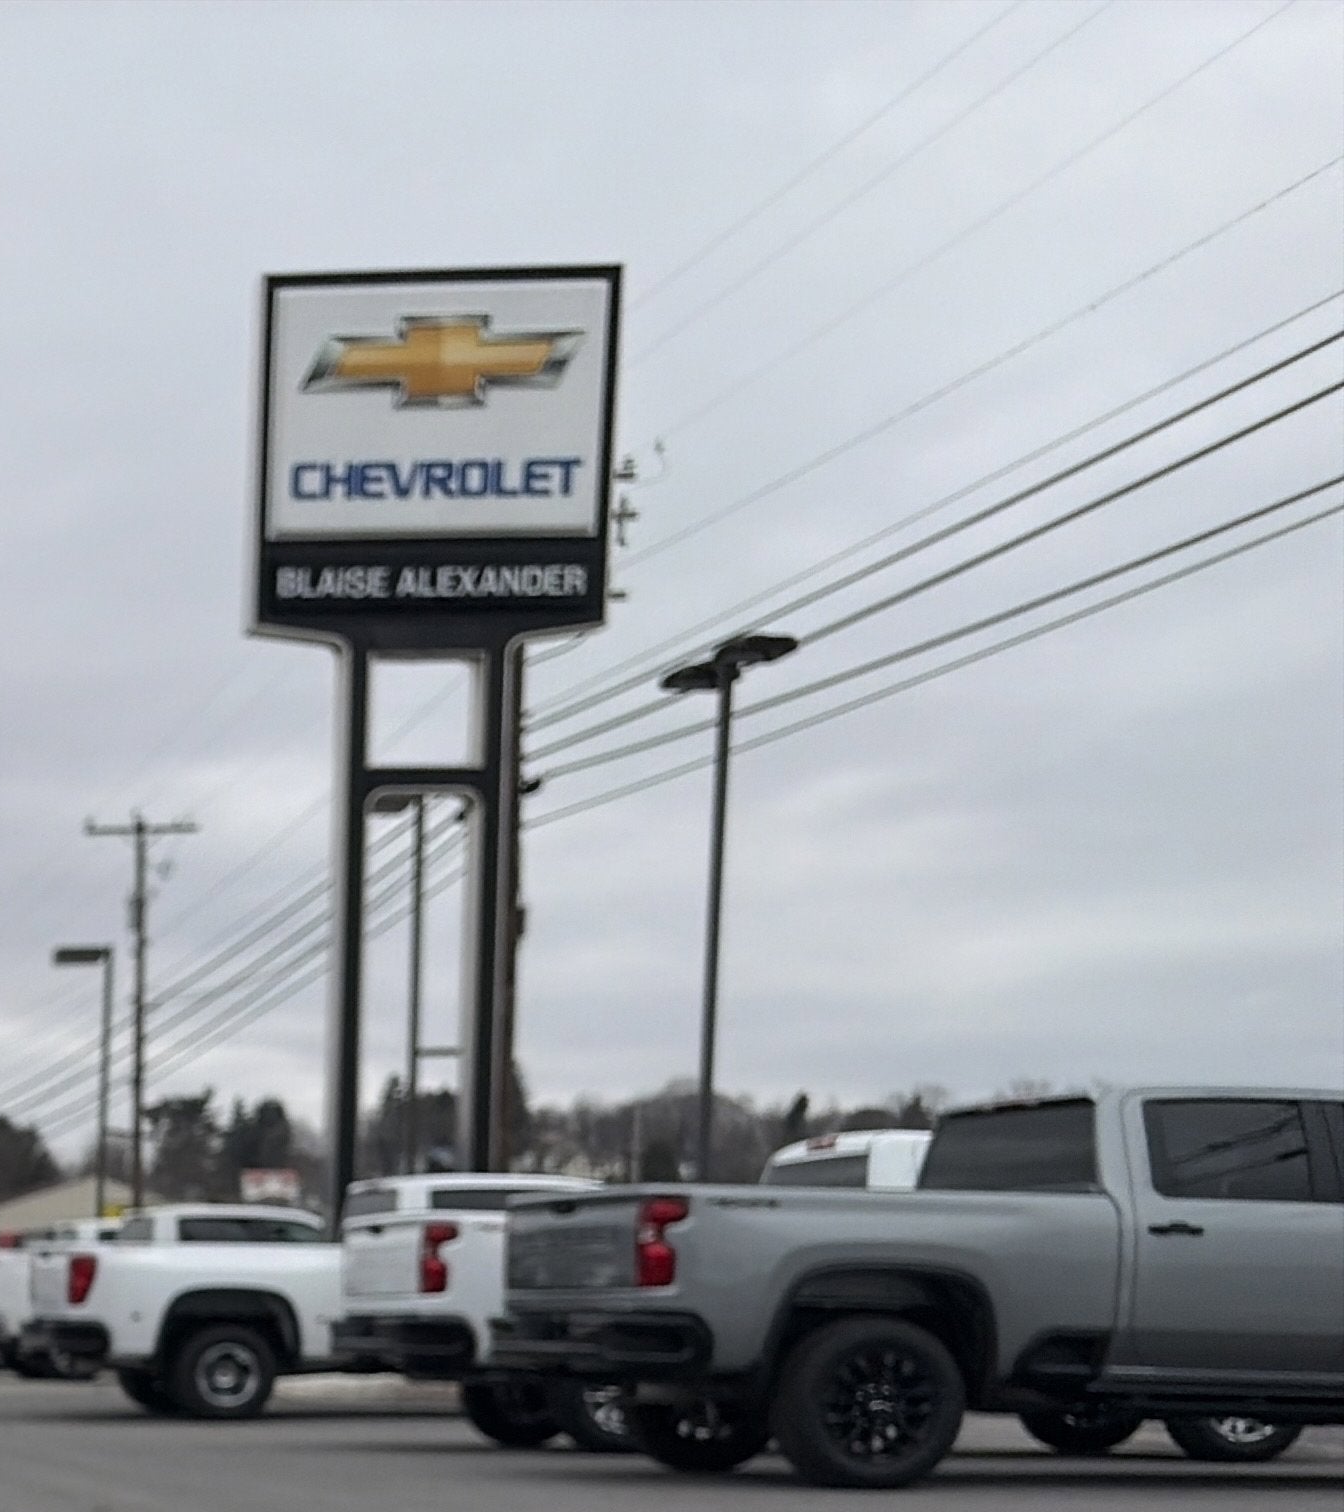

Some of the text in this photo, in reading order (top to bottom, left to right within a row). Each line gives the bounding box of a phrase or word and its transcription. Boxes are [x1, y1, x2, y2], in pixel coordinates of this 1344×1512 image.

[291, 457, 582, 500] CHEVROLET
[276, 564, 588, 599] BLAISE ALEXANDER
